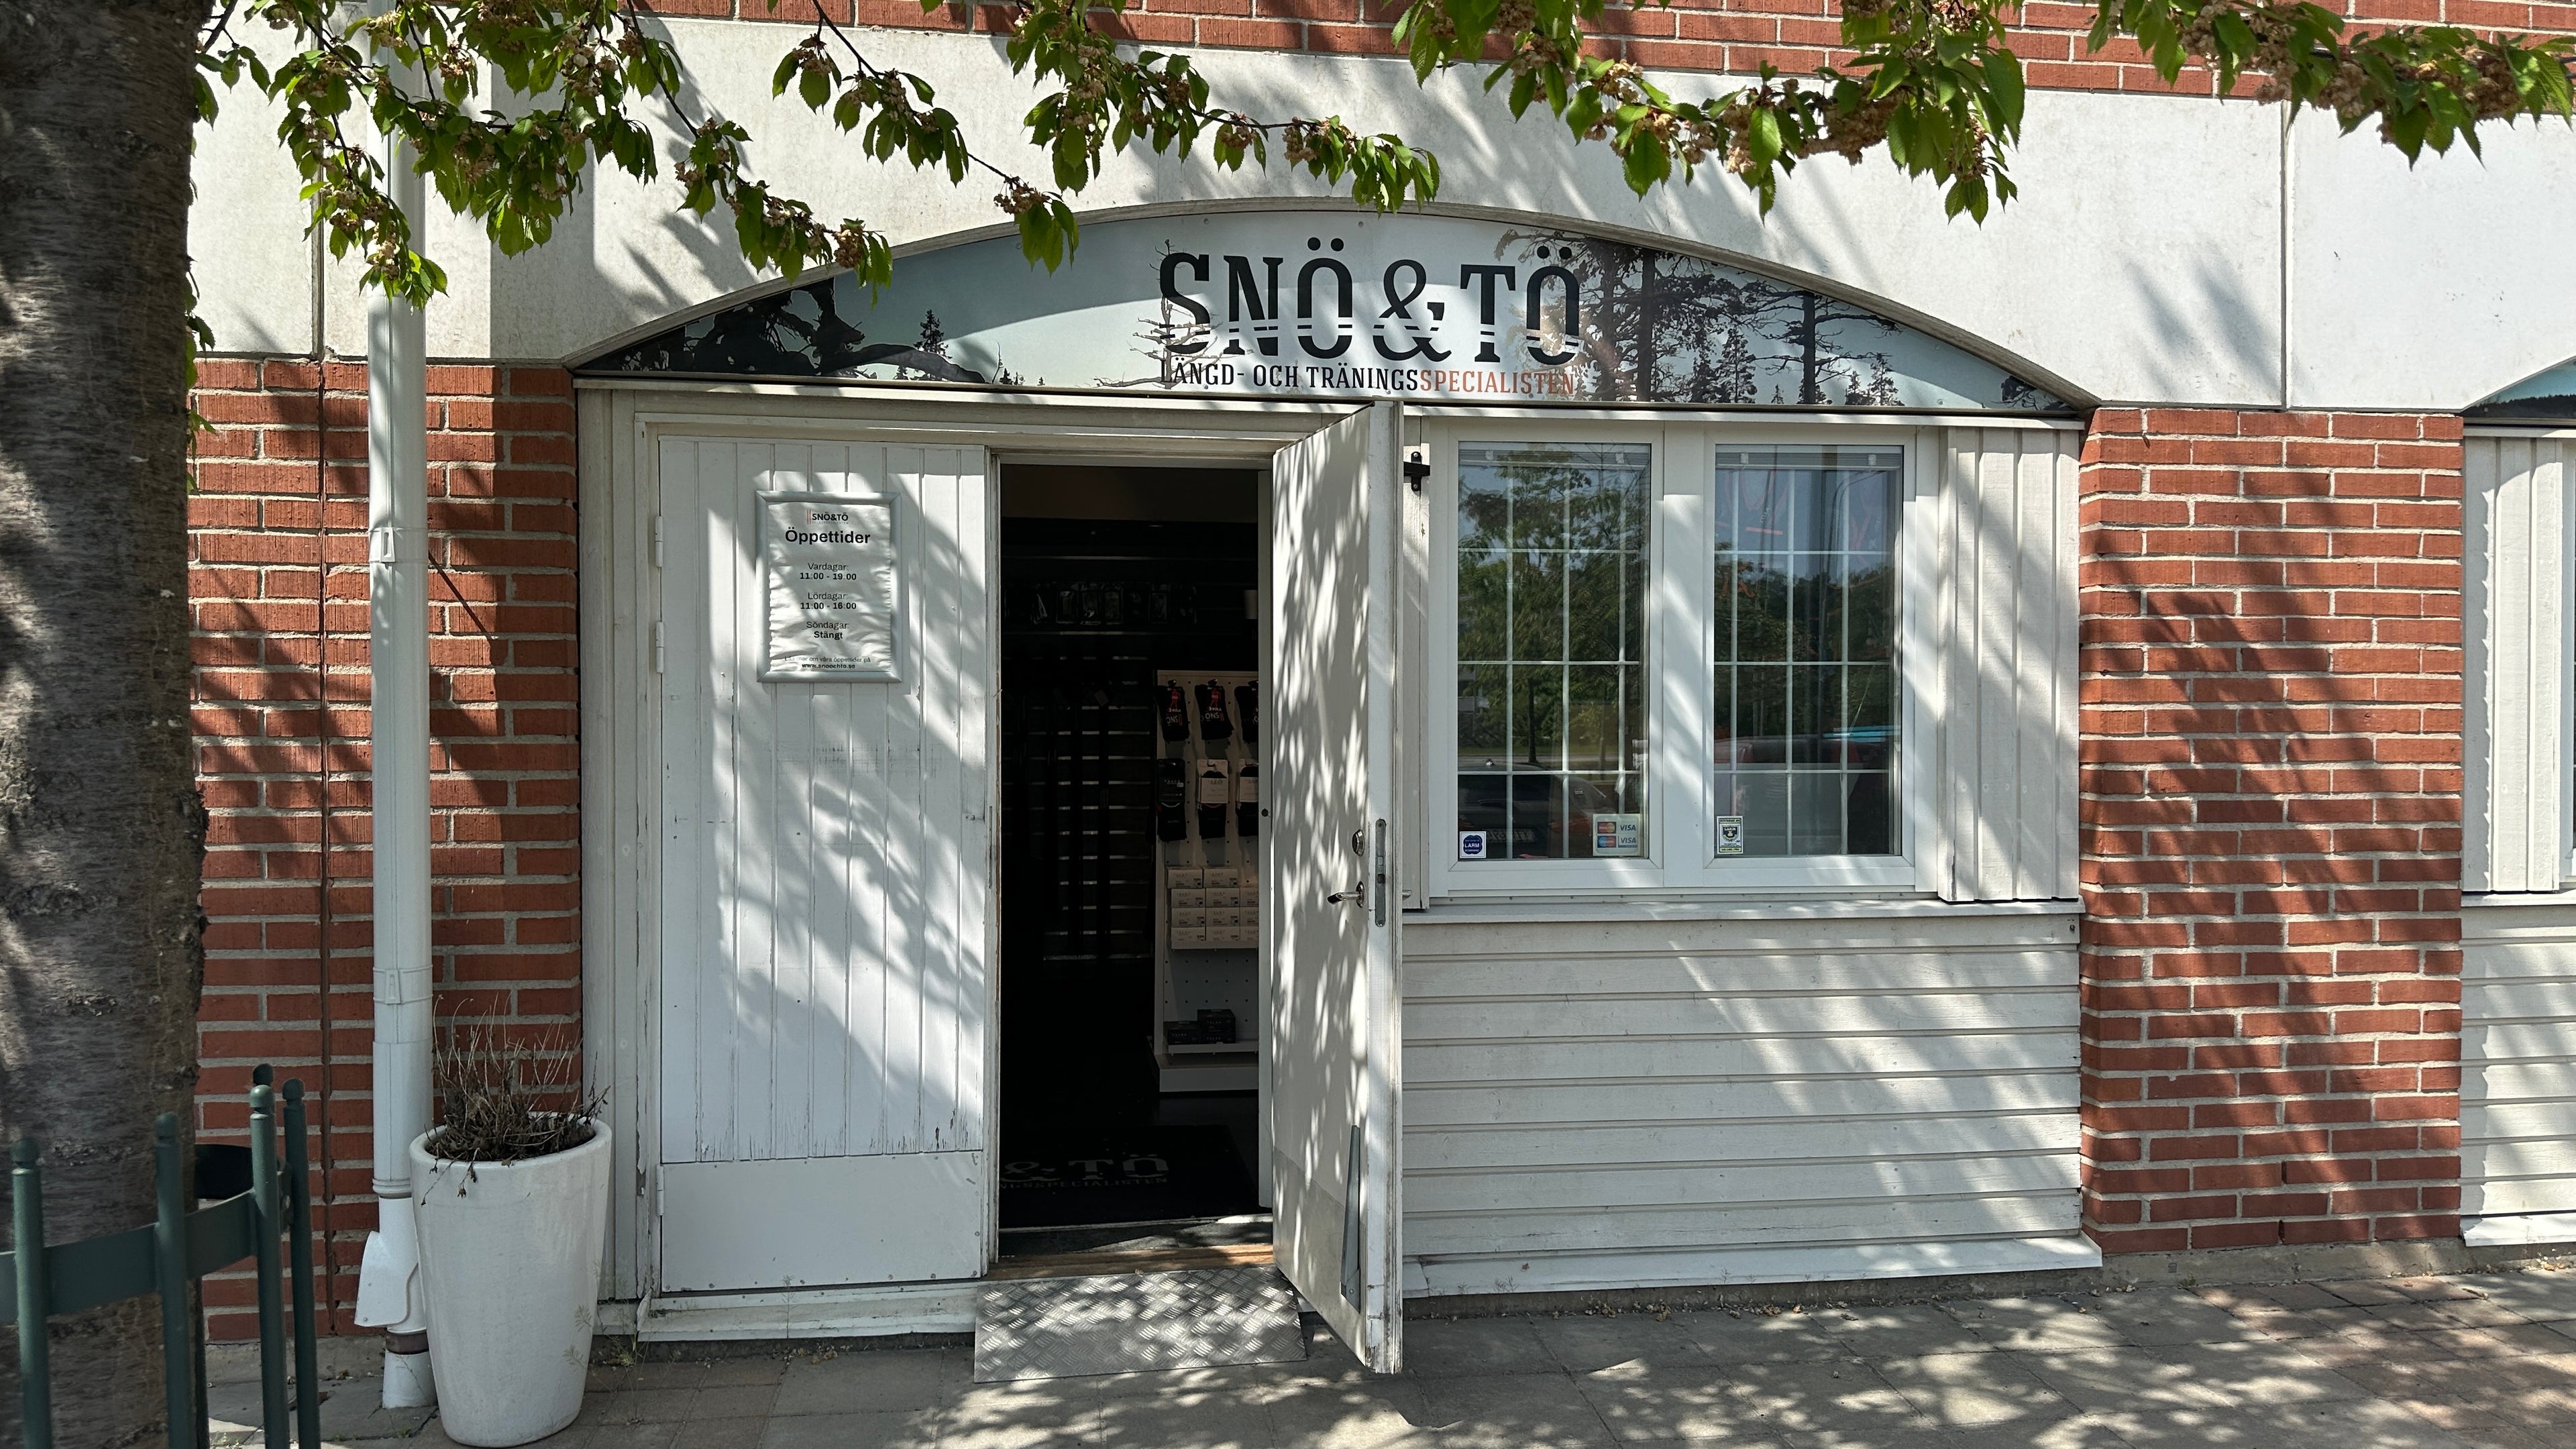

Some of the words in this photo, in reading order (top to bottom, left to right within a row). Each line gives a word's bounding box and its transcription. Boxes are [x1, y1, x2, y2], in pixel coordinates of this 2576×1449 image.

[1253, 364, 1299, 388] OCH
[812, 511, 849, 521] SNÖ&TÖ
[785, 527, 871, 545] Öppettider
[800, 572, 824, 580] 11:00
[814, 631, 843, 640] Stängt
